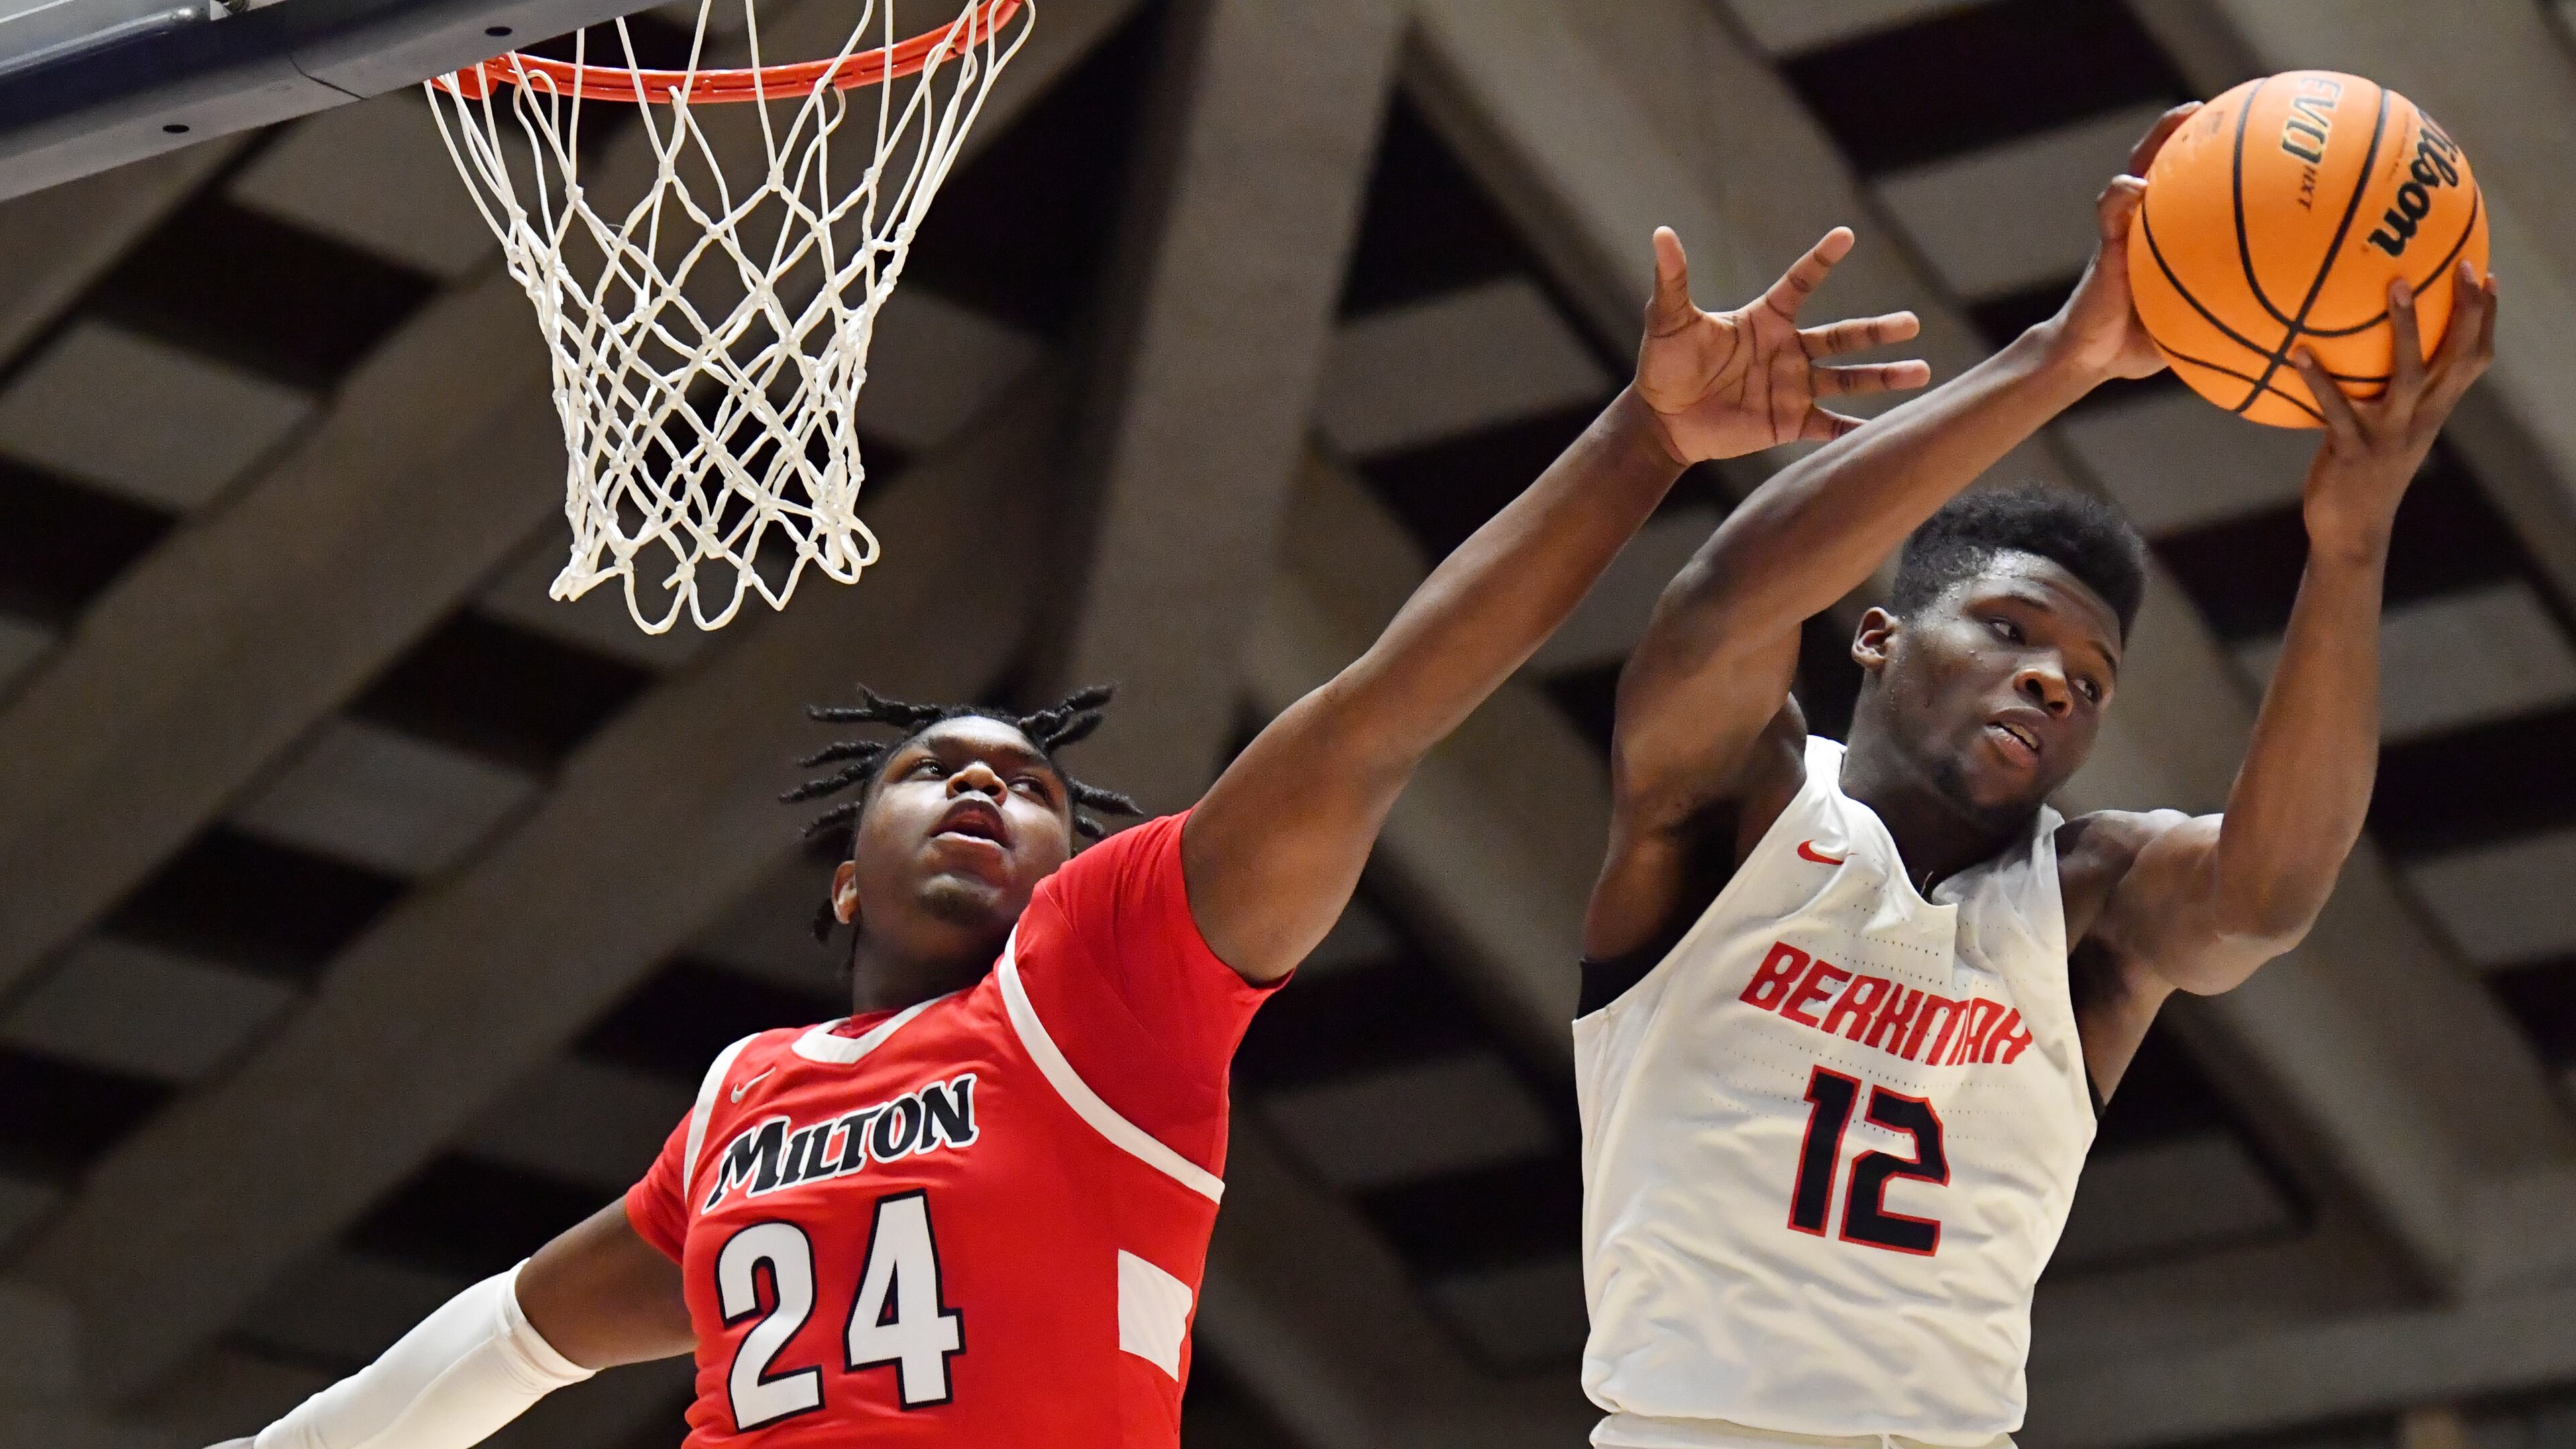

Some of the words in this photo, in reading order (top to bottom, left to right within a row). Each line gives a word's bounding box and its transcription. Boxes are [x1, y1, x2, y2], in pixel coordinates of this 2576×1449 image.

[2282, 76, 2342, 164] EVO
[702, 1073, 977, 1213] MILTON
[1787, 1065, 1950, 1257] 12
[716, 1189, 965, 1432] 24
